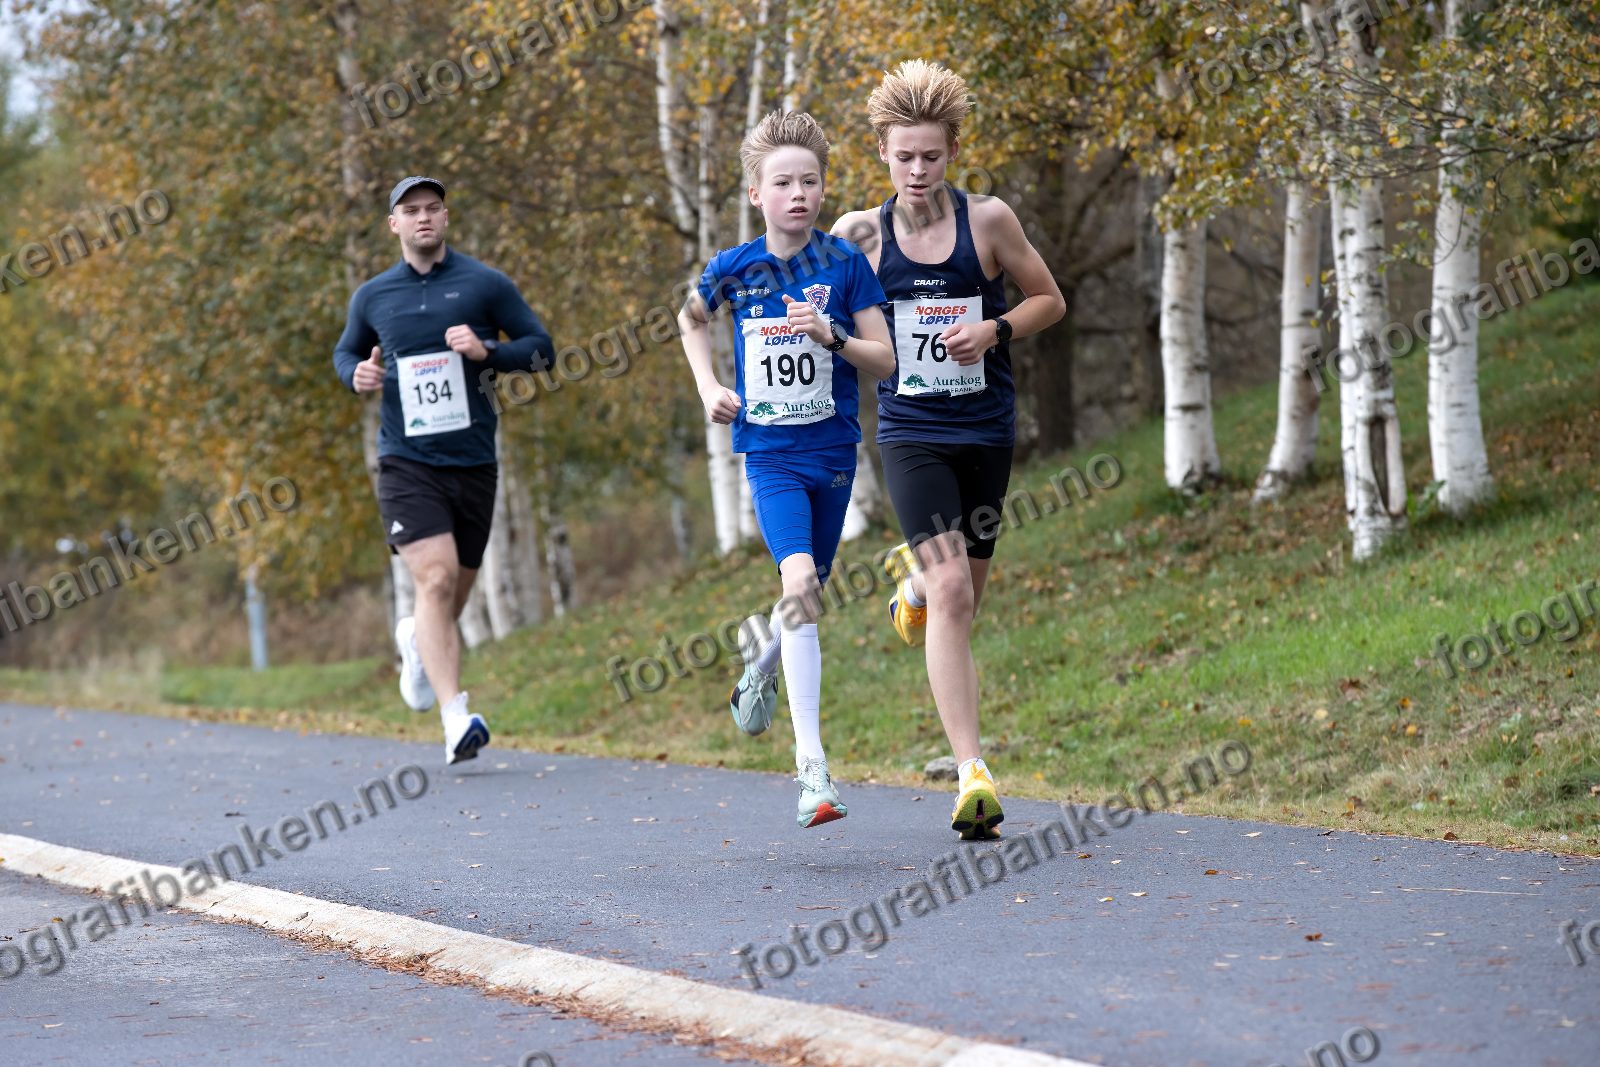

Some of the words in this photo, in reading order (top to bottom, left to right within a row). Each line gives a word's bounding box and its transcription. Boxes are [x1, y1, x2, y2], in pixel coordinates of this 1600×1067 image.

[736, 288, 762, 298] CRAFT
[914, 305, 968, 316] NORGES
[918, 315, 959, 326] LØPET
[764, 333, 806, 347] LØPET
[760, 352, 816, 387] 190
[932, 375, 982, 387] Aurskog
[413, 378, 453, 405] 134
[782, 398, 832, 412] Aurskog
